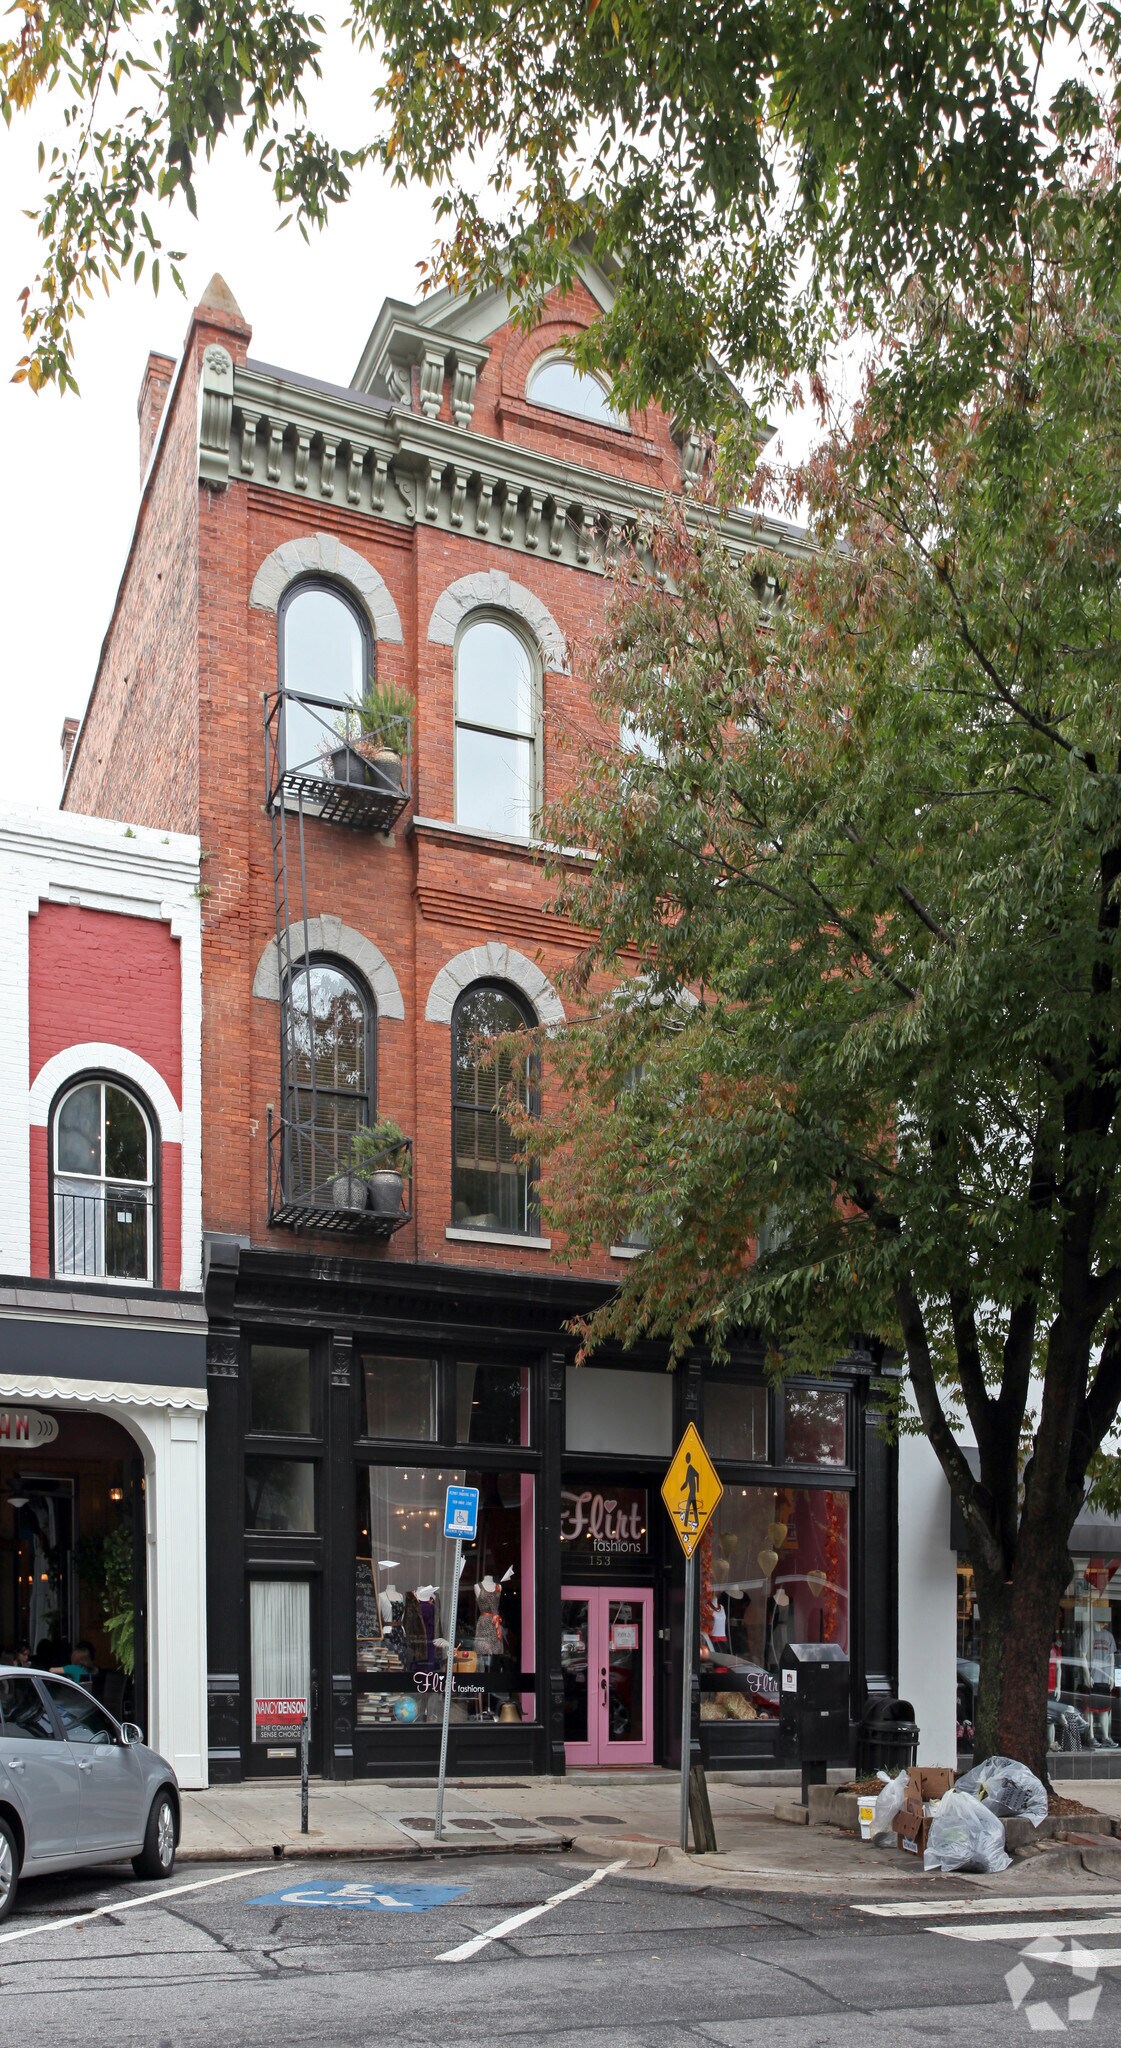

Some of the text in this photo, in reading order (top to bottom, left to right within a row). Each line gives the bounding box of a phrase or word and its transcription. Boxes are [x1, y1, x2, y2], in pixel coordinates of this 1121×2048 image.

[561, 1491, 642, 1540] Flirt
[593, 1538, 641, 1552] fashions
[590, 1555, 611, 1566] 153
[413, 1671, 485, 1693] Flit fashions
